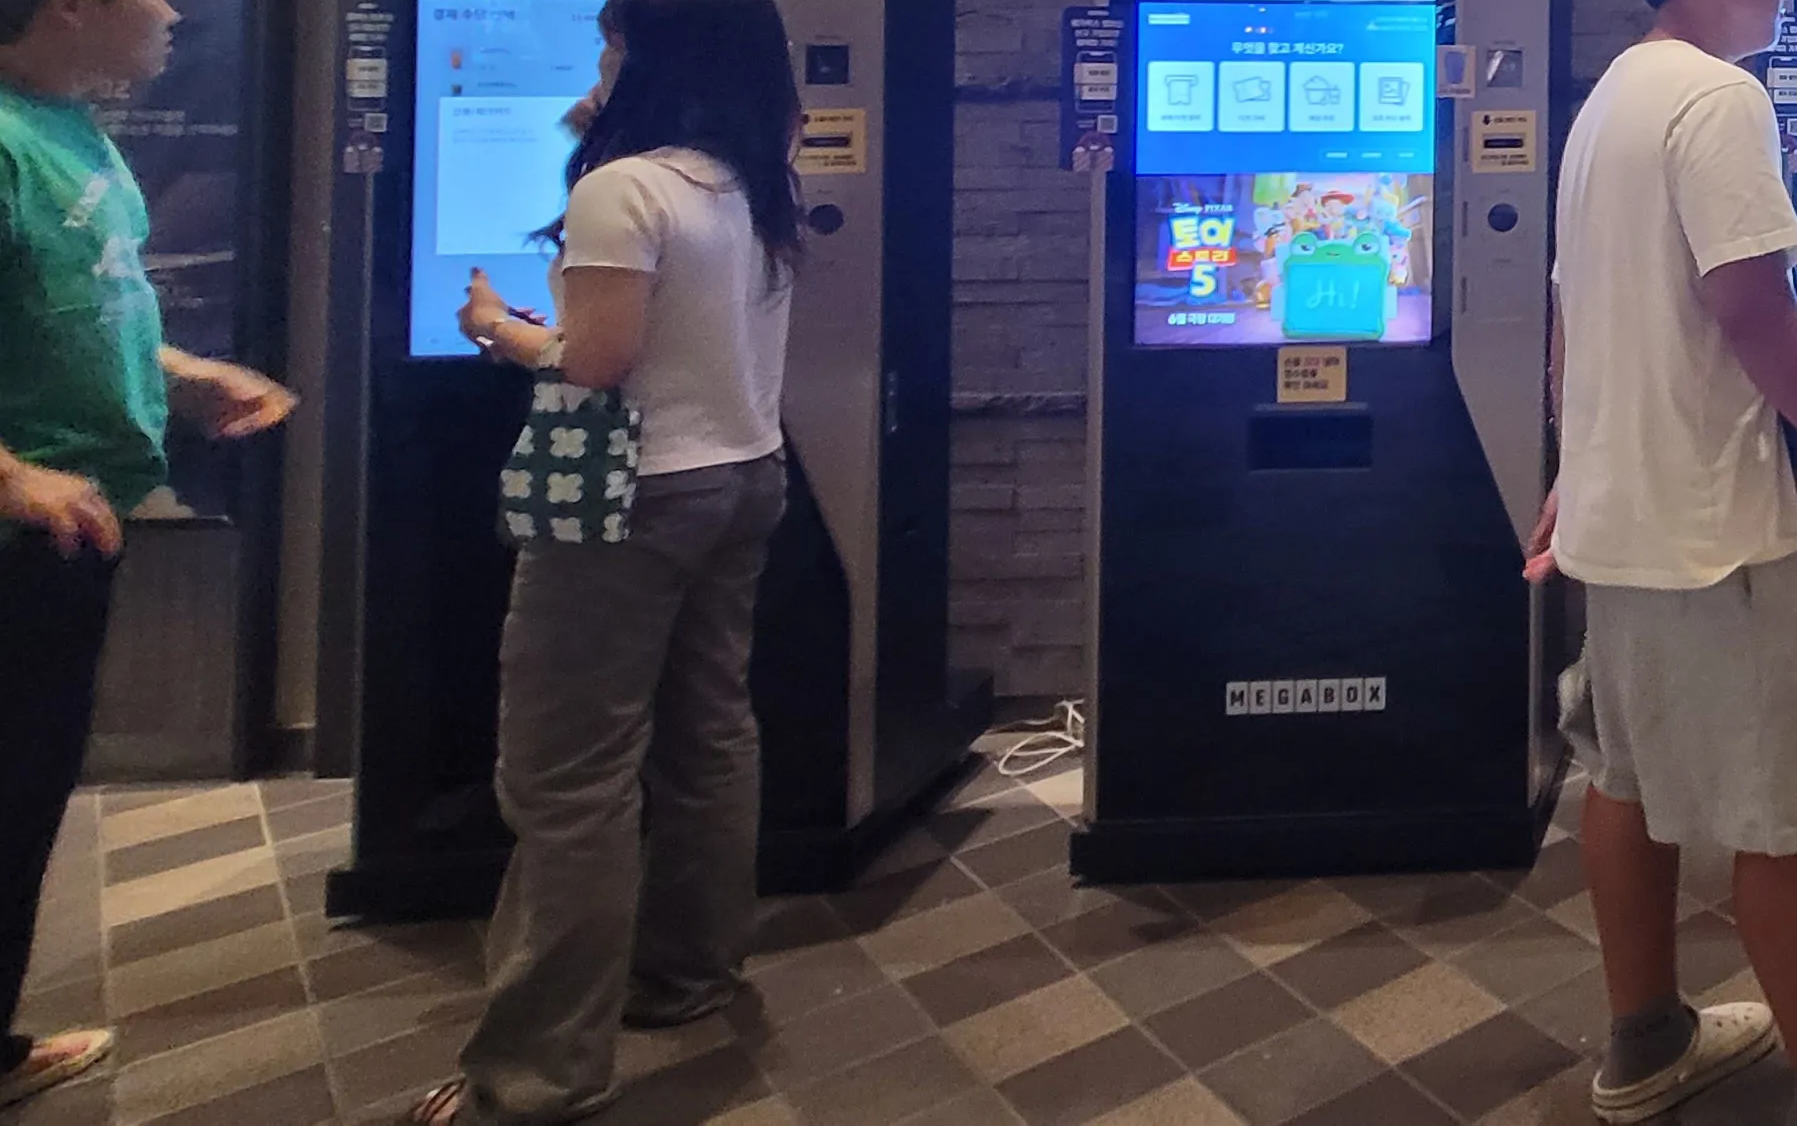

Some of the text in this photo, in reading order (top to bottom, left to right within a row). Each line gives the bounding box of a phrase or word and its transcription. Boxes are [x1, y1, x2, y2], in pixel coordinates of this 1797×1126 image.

[1171, 217, 1235, 248] 토이
[1176, 250, 1229, 262] 스토리
[1191, 263, 1217, 298] 5
[1229, 683, 1383, 710] MEGABOX
